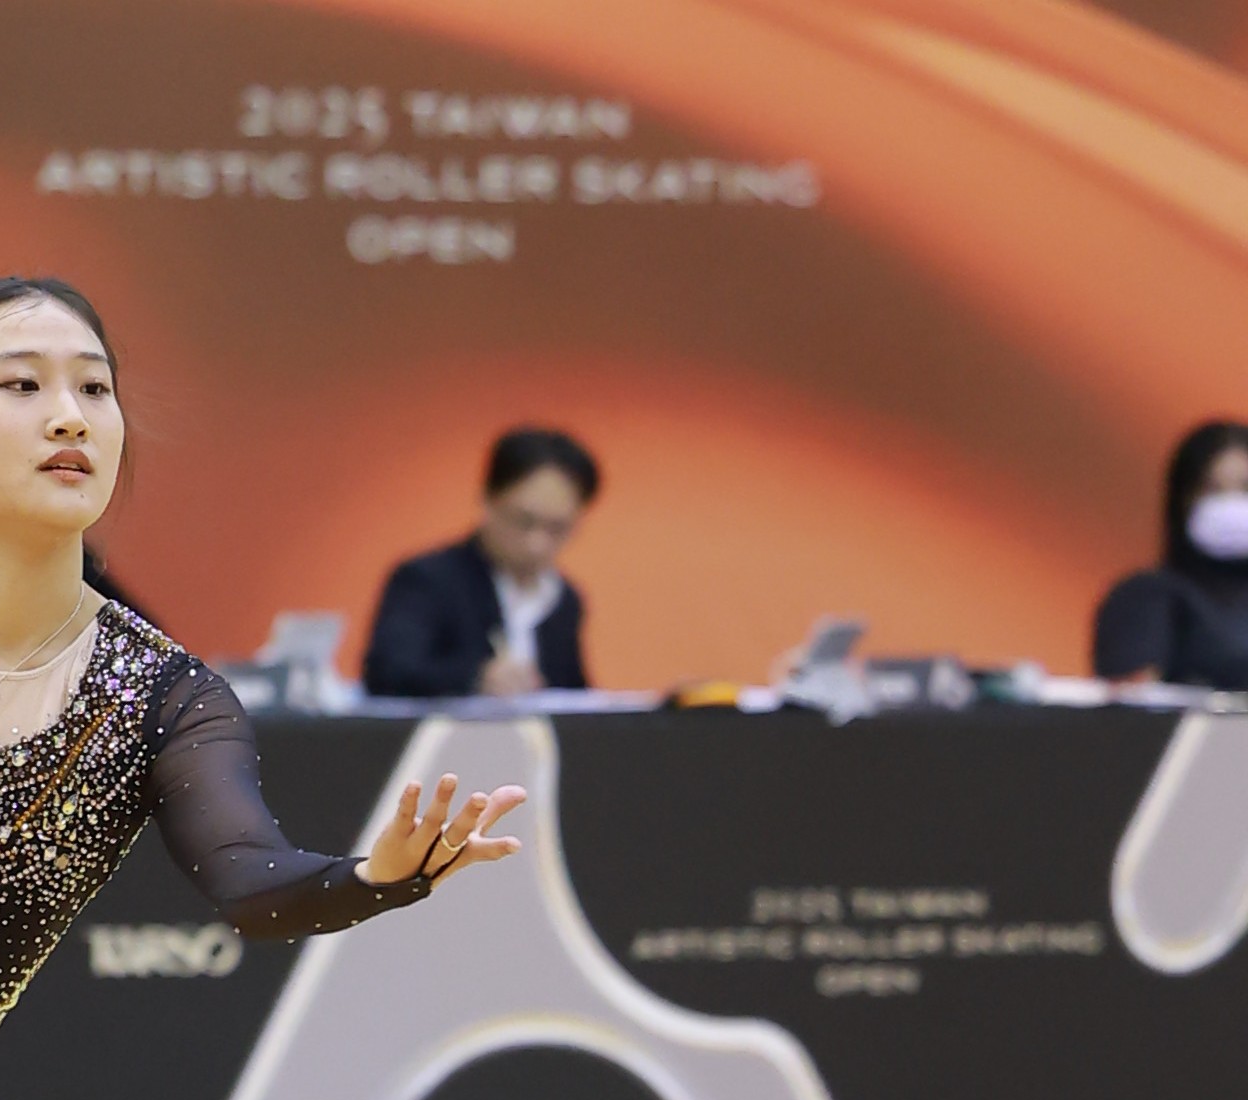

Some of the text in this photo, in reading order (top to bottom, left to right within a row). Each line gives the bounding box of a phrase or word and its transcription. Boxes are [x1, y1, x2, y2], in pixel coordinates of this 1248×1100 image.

[405, 92, 631, 138] TAIWAN
[38, 150, 818, 206] ARTISTIC ROLLER SKATING
[347, 217, 514, 263] OPEN
[633, 923, 1102, 959] ARTISTIC ROLLER SKATING
[817, 965, 921, 996] OPEN
